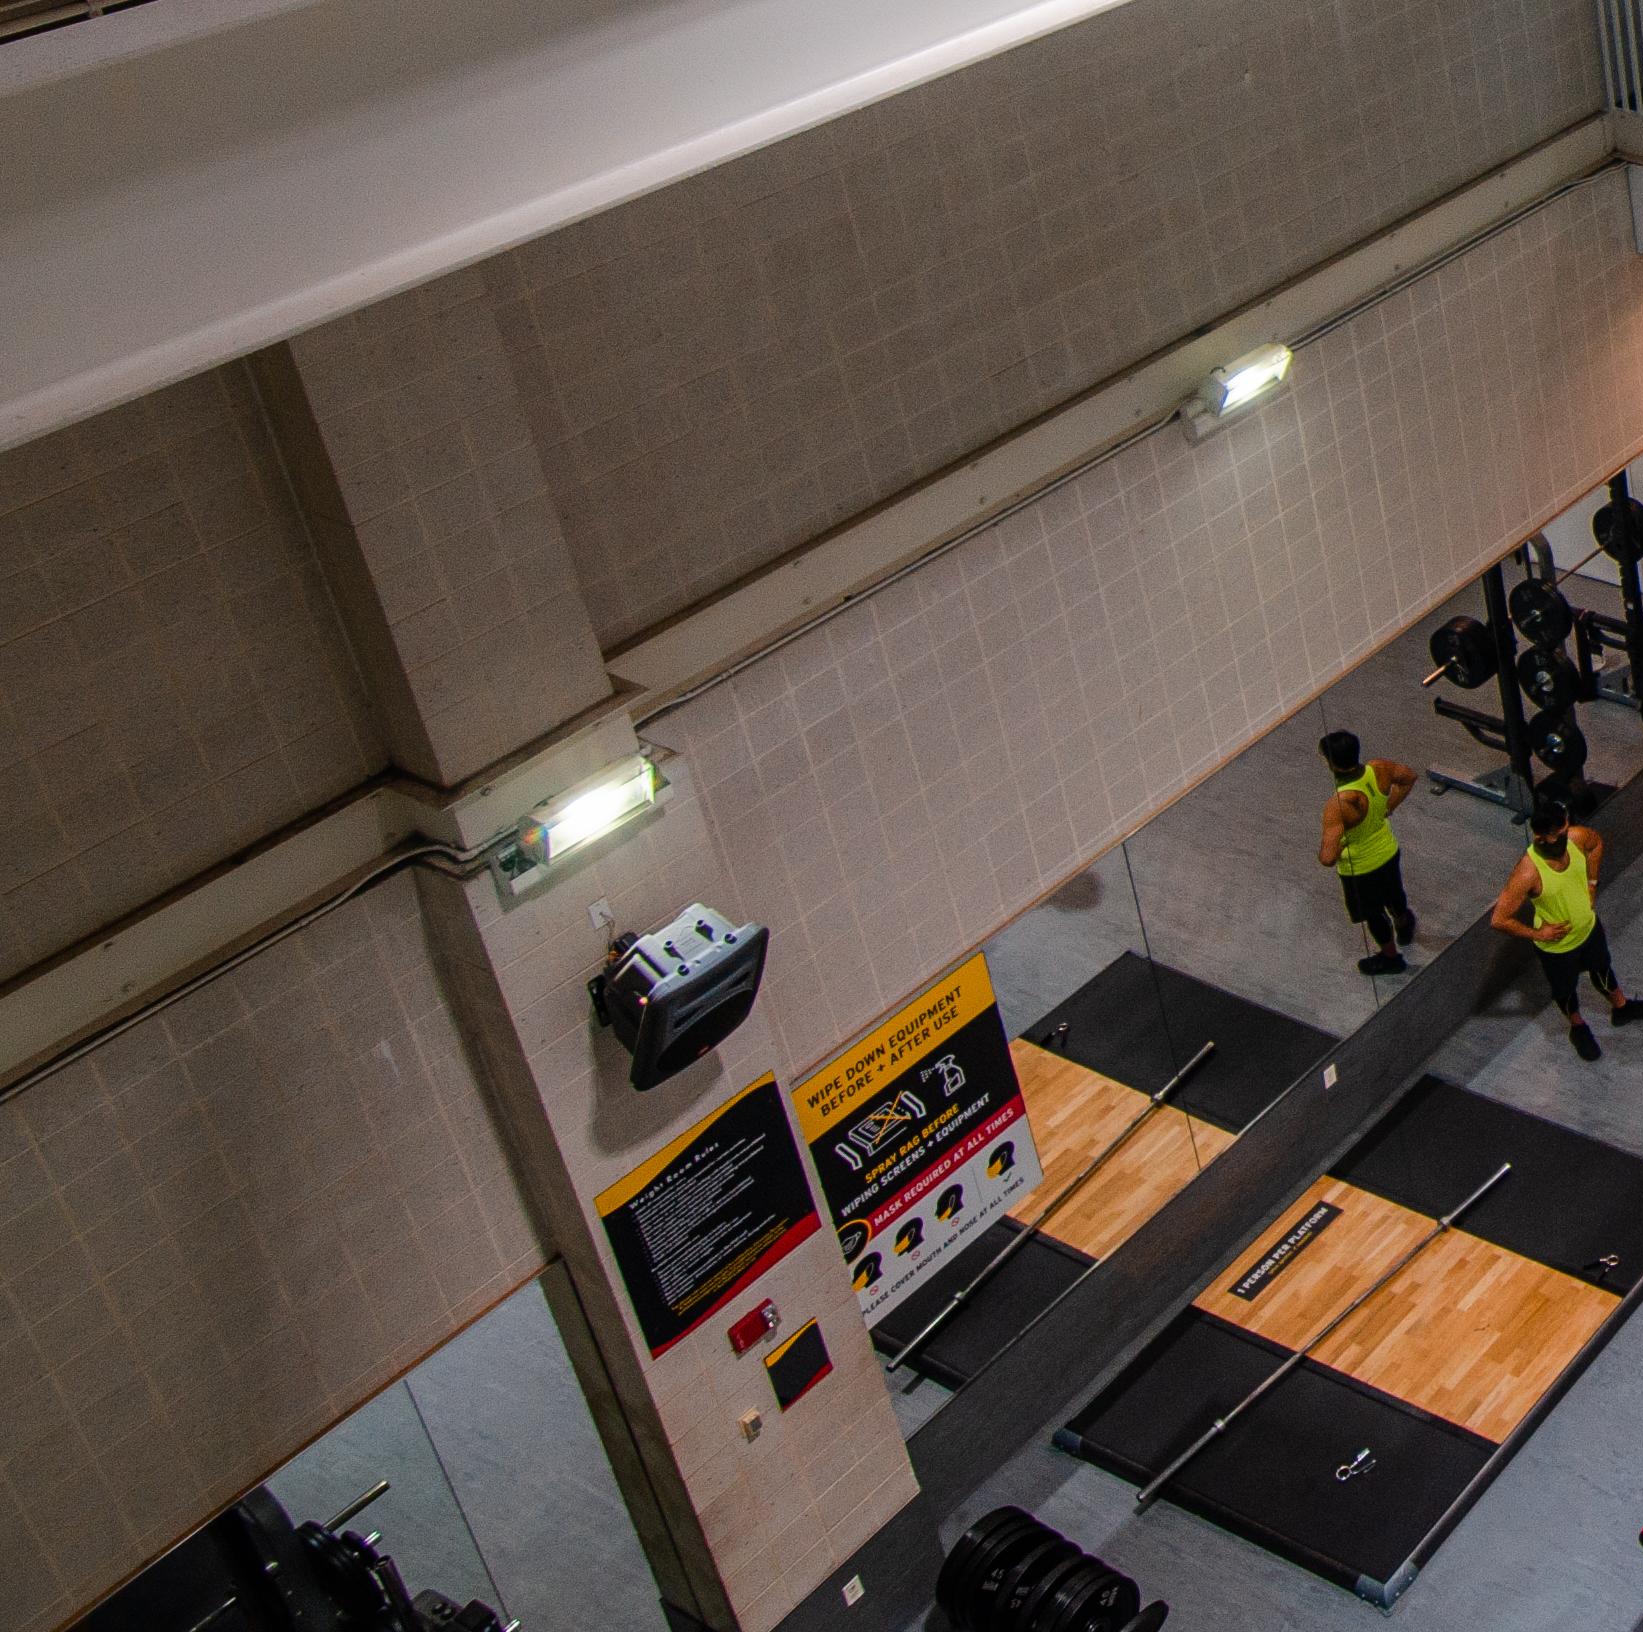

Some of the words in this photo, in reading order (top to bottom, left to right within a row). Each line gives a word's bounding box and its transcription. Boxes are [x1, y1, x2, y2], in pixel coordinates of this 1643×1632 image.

[806, 1076, 842, 1109] WIPE
[845, 1044, 886, 1080] DOWN
[888, 986, 962, 1049] EQUIPMENT
[820, 1071, 874, 1118] BEFORE
[890, 1028, 931, 1066] AFTER
[933, 1005, 959, 1031] USE
[841, 1183, 879, 1217] WIPING
[880, 1146, 926, 1187] SCREENS
[935, 1093, 990, 1142] EQUIPMENT
[864, 1153, 897, 1184] SPRAY
[899, 1135, 921, 1158] RAG
[922, 1103, 960, 1139] BEFORE
[874, 1200, 903, 1227] MASK
[903, 1160, 952, 1202] REQUIRED
[953, 1149, 965, 1163] AT
[967, 1134, 985, 1152] ALL
[985, 1108, 1015, 1135] TIMES
[890, 1270, 915, 1293] COVER
[916, 1247, 943, 1272] MOUTH
[943, 1232, 958, 1249] AND
[958, 1216, 978, 1235] NOSE
[989, 1197, 1003, 1210] ALL
[1003, 1177, 1025, 1197] TIMES
[1242, 1259, 1276, 1289] PERSON
[1272, 1244, 1291, 1260] PER
[1287, 1207, 1329, 1245] PLATFORM
